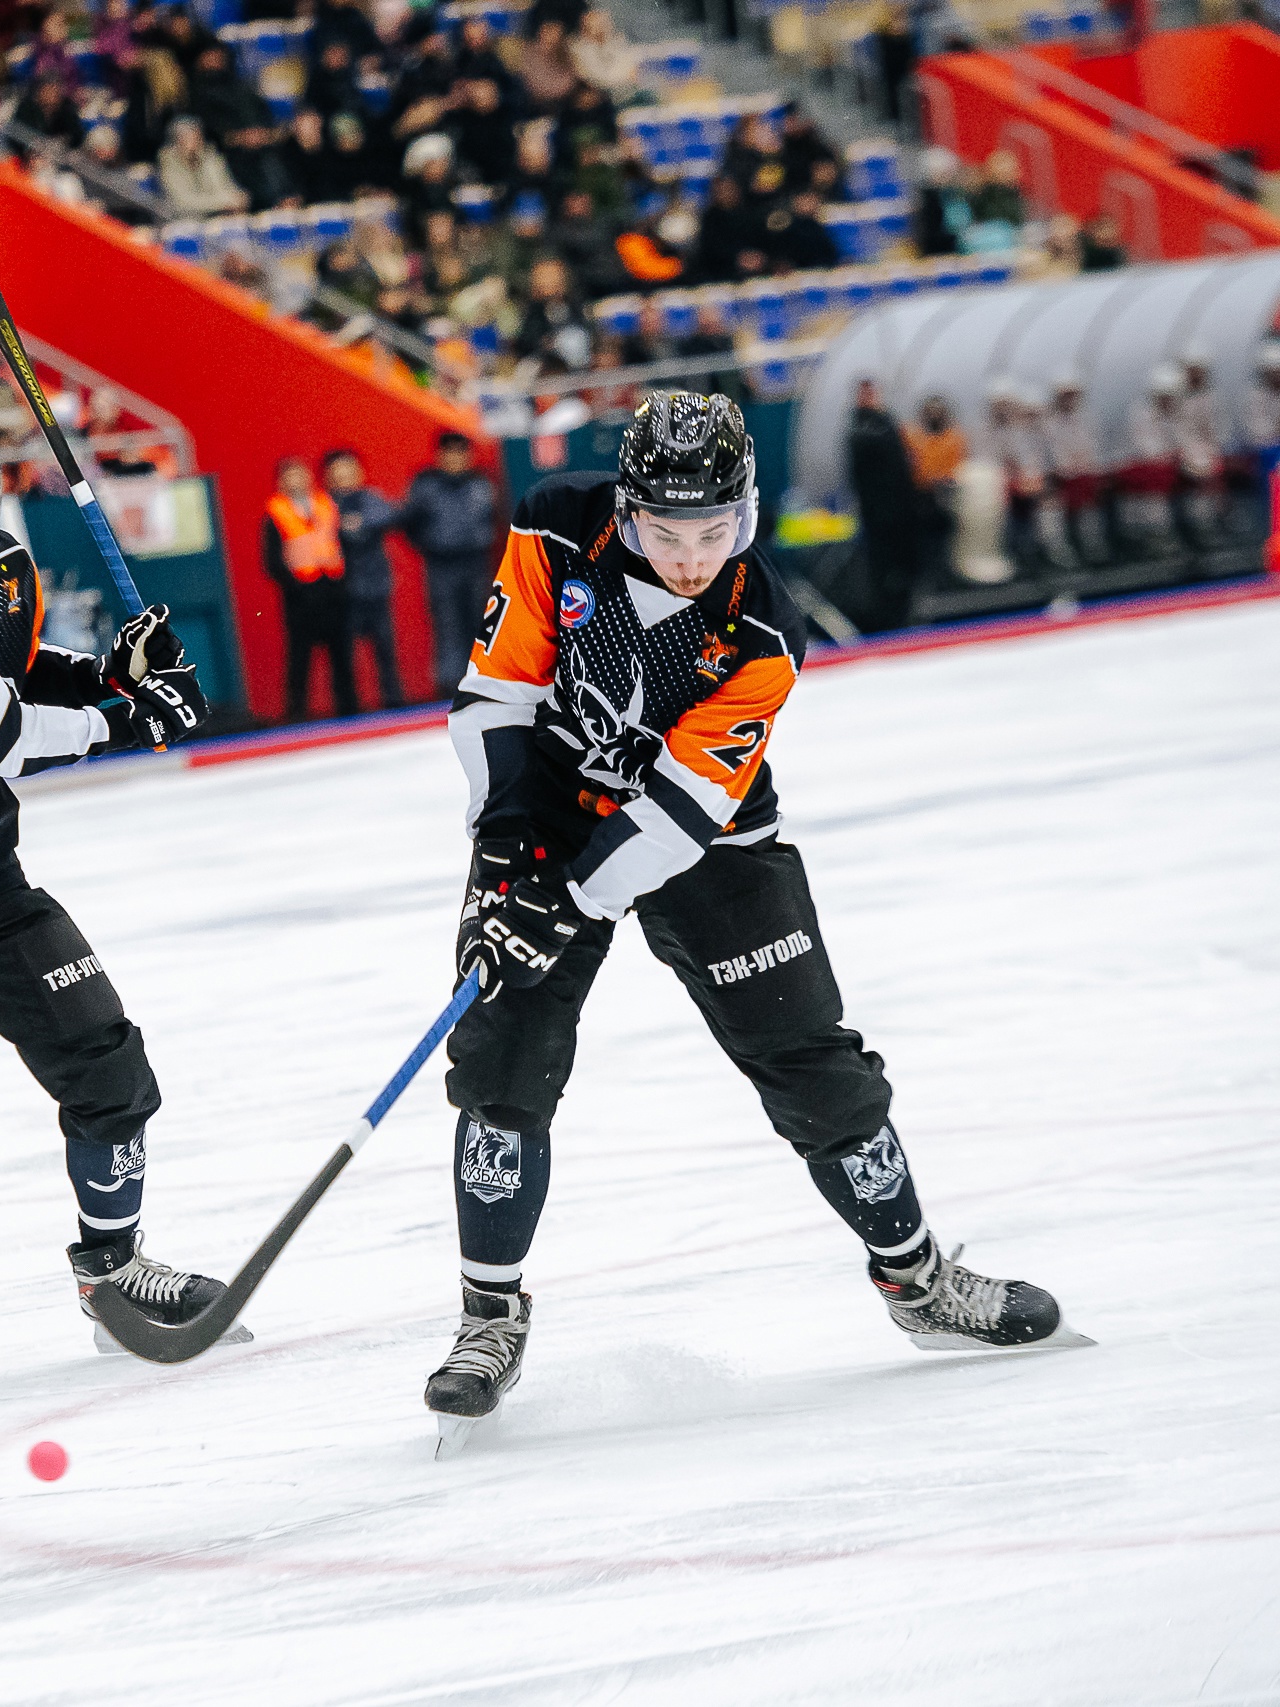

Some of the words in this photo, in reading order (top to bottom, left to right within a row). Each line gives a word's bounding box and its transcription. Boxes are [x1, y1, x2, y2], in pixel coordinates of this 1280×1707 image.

[665, 489, 705, 500] CCM
[587, 513, 617, 563] КУЗБАС
[727, 562, 747, 617] КУЗБАСС
[138, 675, 197, 729] CCM
[483, 916, 559, 973] CCM
[42, 954, 104, 992] ТЗК-УГО
[462, 1164, 521, 1188] КУЗБАСС
